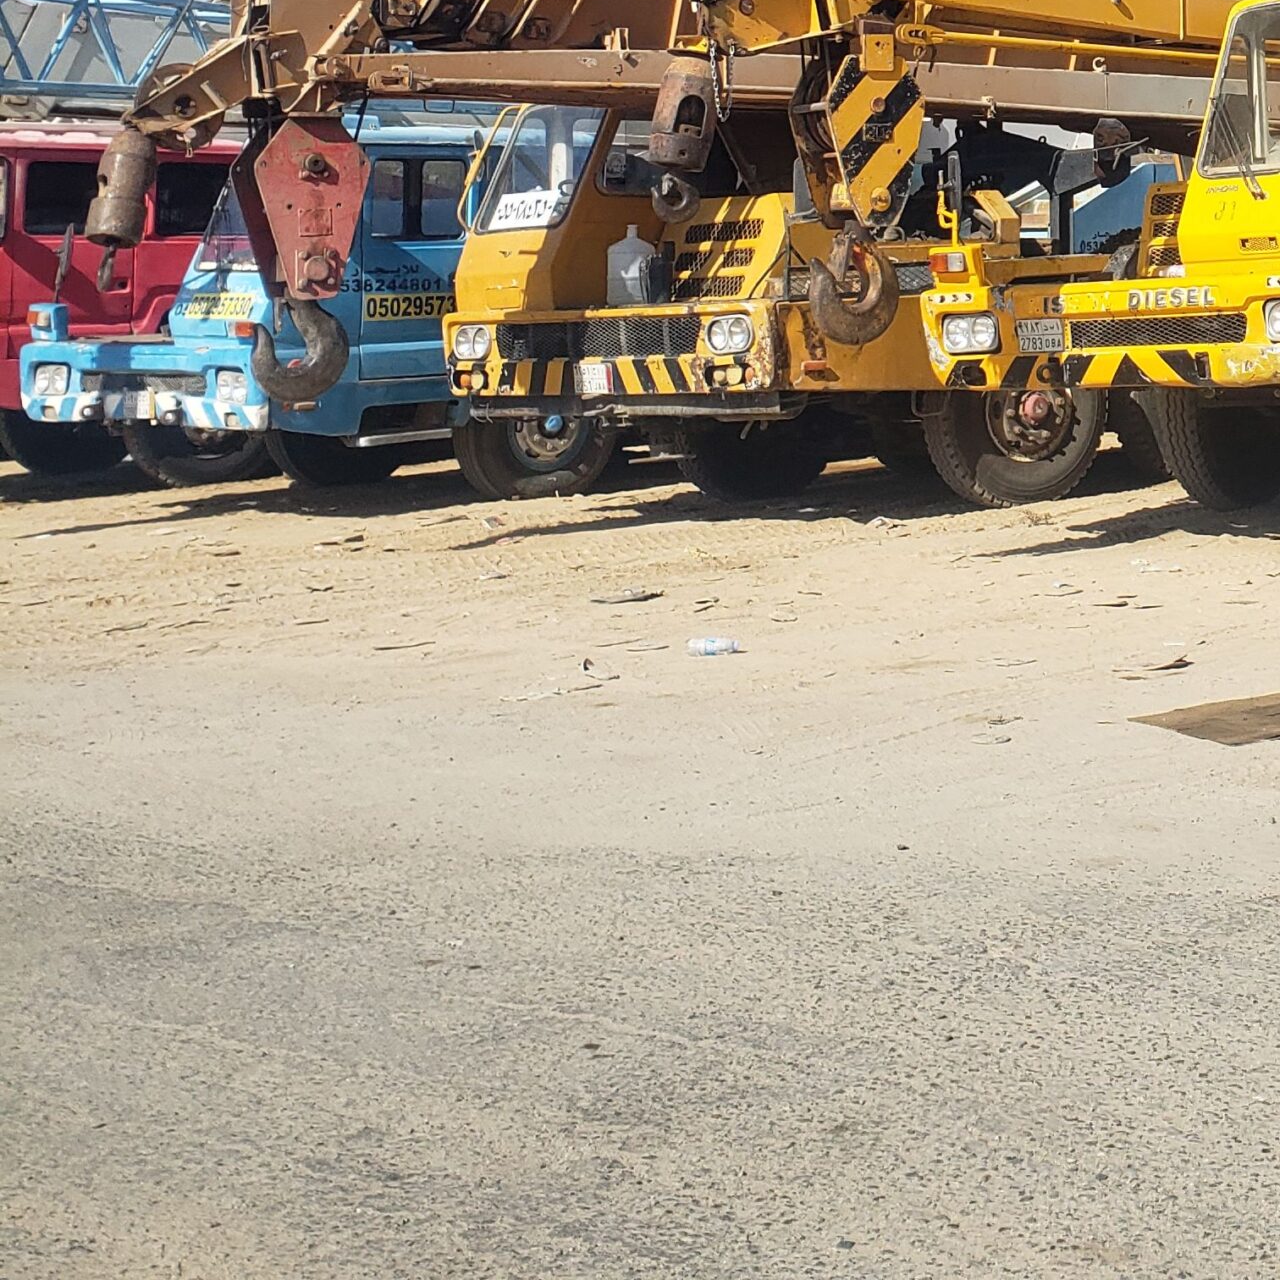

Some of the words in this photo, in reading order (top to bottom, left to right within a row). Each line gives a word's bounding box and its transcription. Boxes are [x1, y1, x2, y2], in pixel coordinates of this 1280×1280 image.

[340, 278, 441, 292] 538244801
[366, 295, 456, 317] 05029573
[1127, 287, 1215, 310] DIESEL
[1020, 336, 1044, 351] 2783
